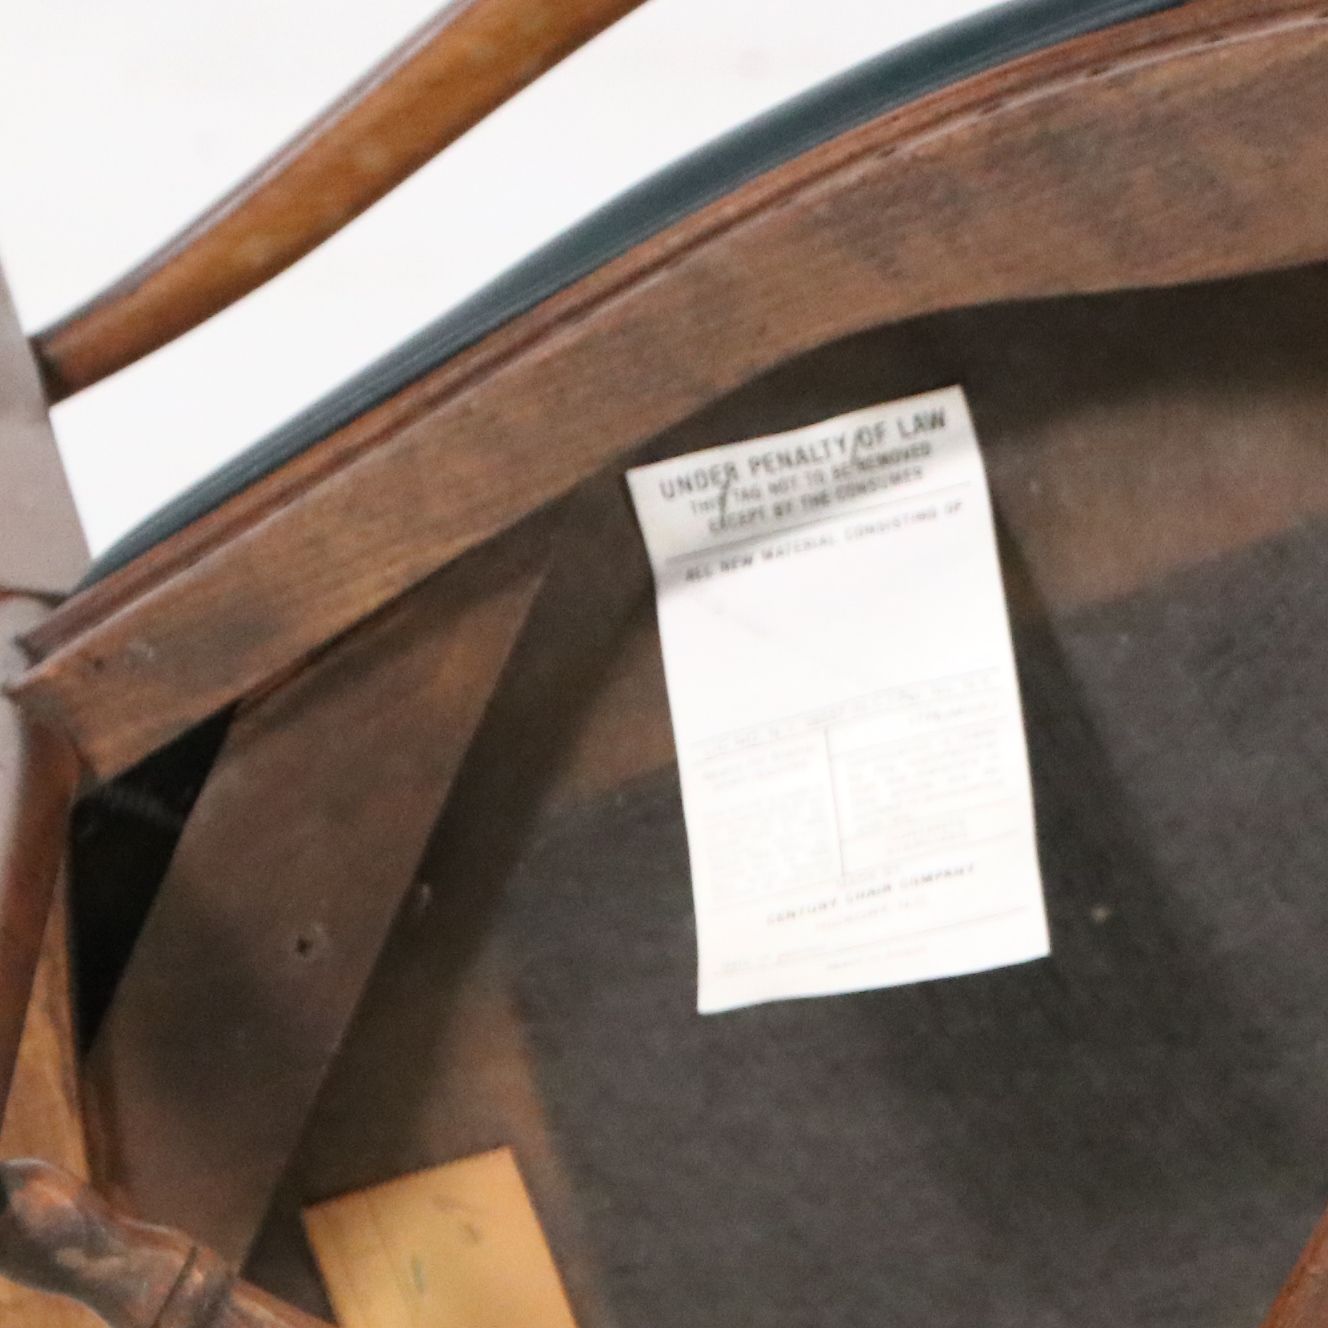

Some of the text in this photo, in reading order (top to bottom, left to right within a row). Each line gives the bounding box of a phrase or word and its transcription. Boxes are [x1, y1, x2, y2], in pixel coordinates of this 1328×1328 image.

[660, 407, 946, 499] UNDER PENALTY OF LAW
[767, 477, 801, 494] NOT
[801, 489, 831, 509] THE
[720, 553, 754, 572] NEW
[944, 500, 964, 514] OF
